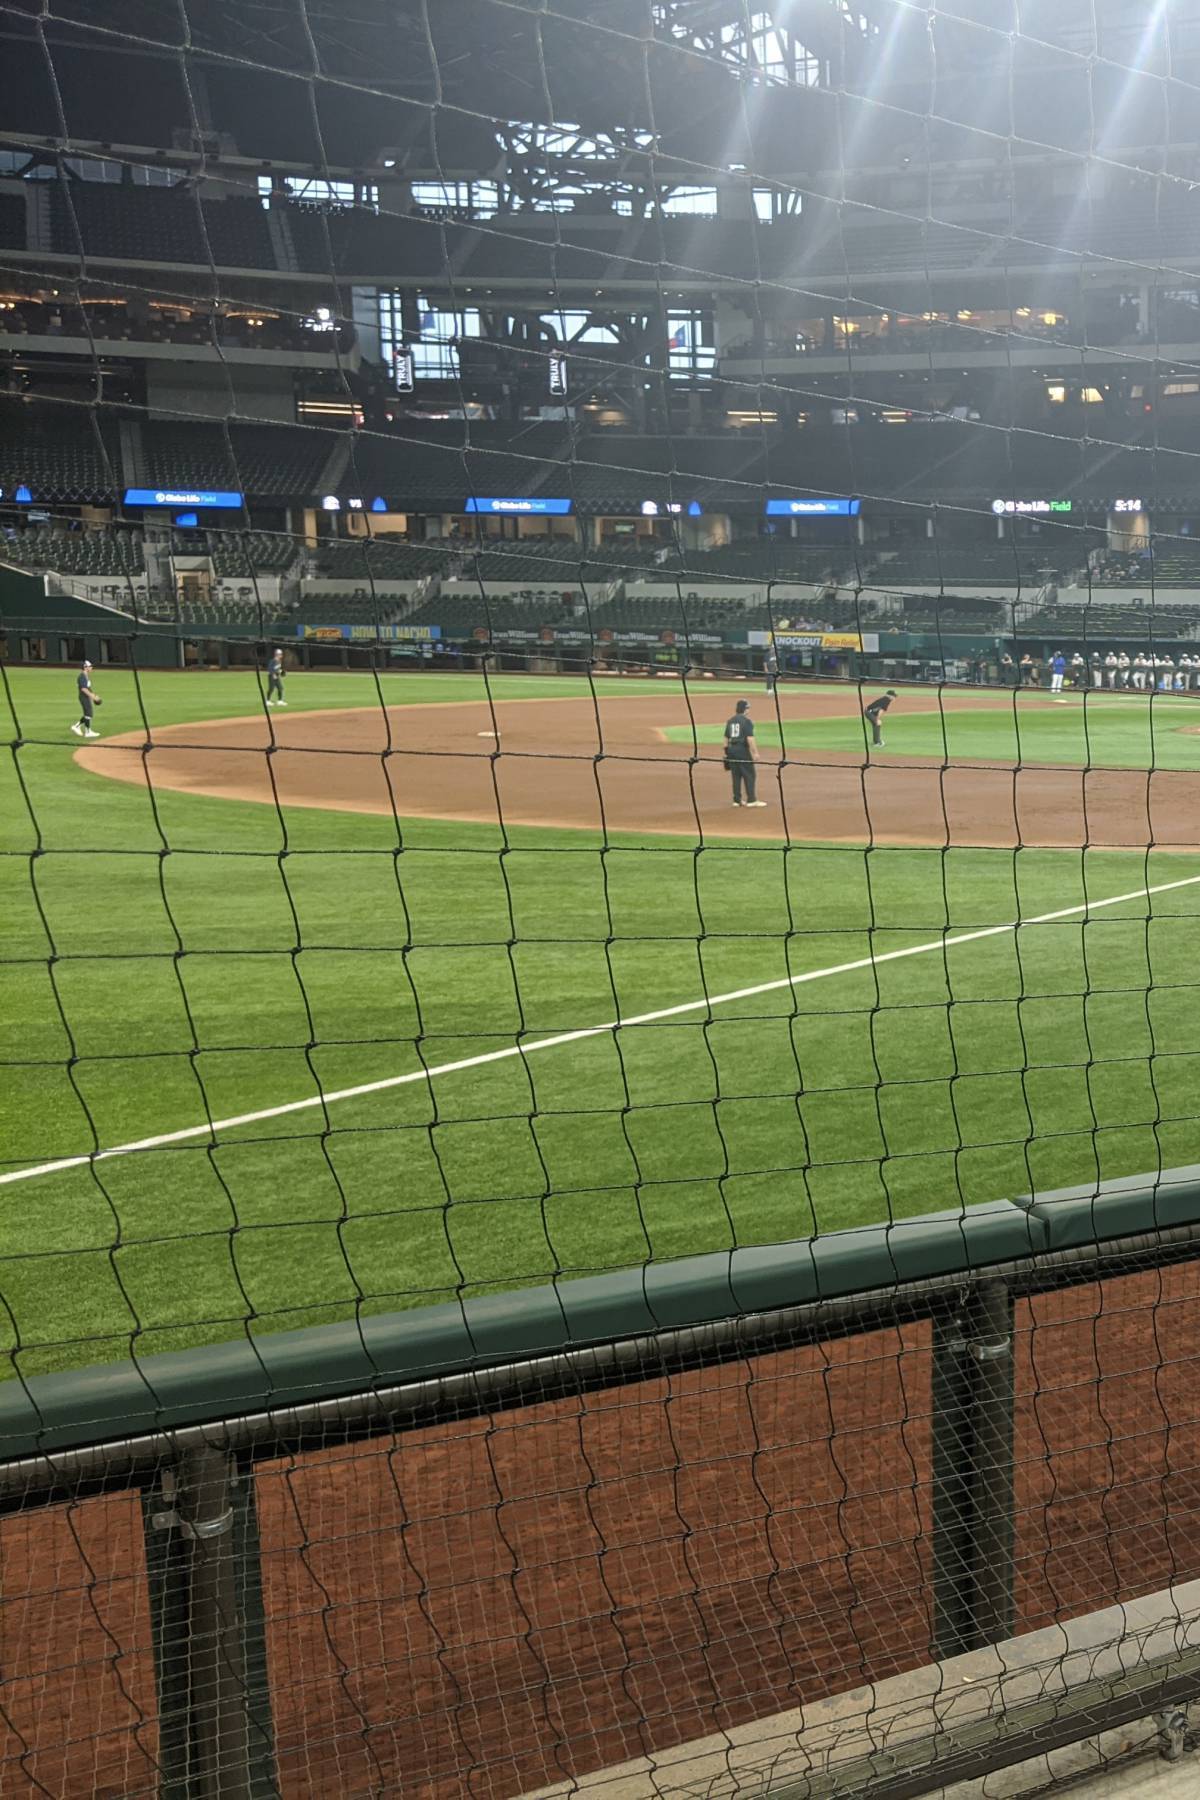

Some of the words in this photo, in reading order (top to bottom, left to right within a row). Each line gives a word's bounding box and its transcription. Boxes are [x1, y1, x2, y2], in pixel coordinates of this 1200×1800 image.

[396, 355, 406, 385] TRULY
[550, 358, 560, 388] TRULY
[1115, 500, 1142, 512] 5:14
[731, 722, 740, 738] 19
